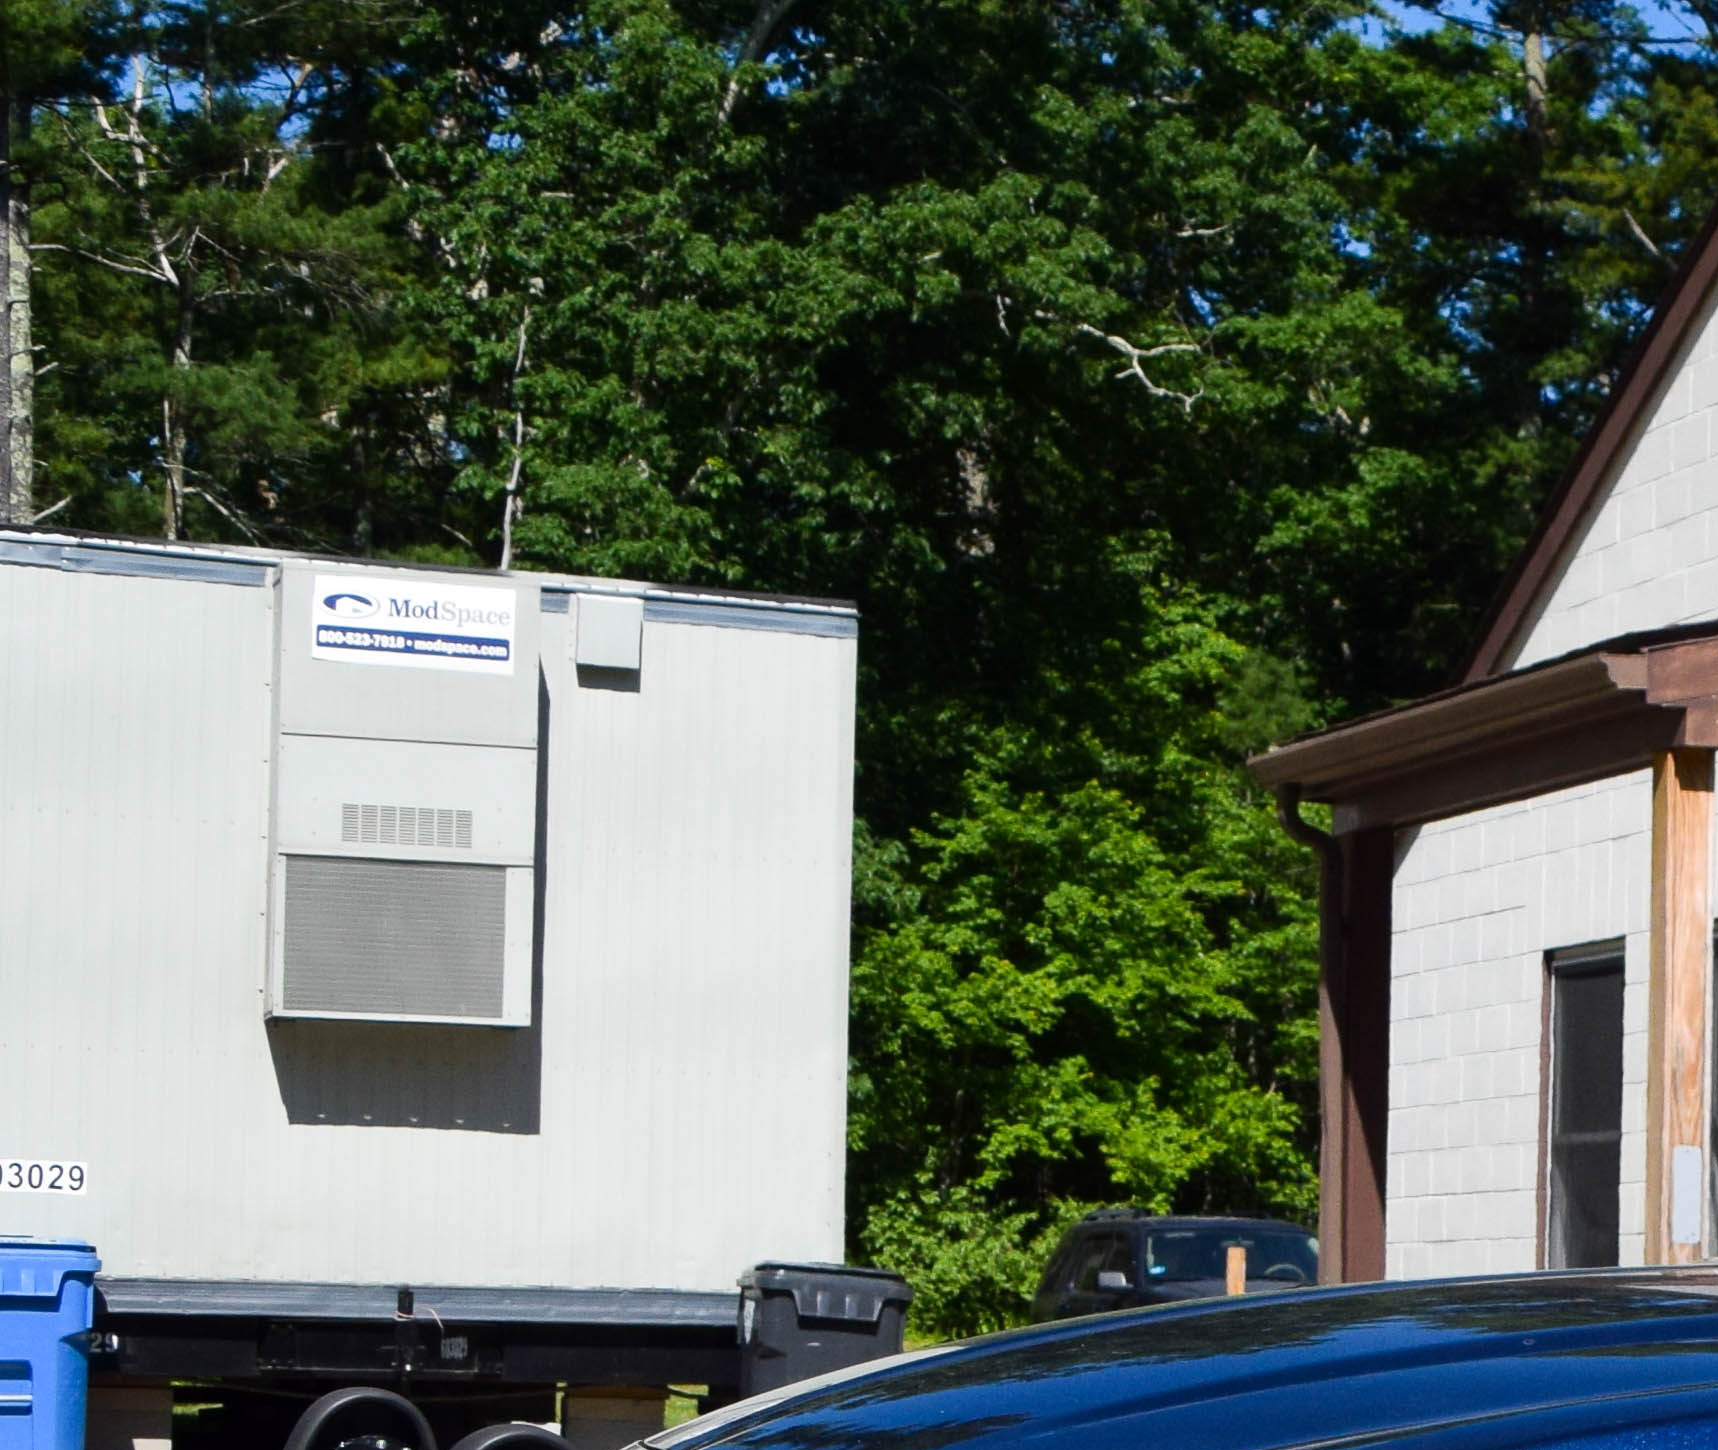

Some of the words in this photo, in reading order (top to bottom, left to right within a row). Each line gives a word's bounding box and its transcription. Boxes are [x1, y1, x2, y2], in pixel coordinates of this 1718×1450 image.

[388, 598, 511, 627] ModSpace
[414, 638, 508, 657] modspace.com
[0, 1162, 84, 1191] 3029
